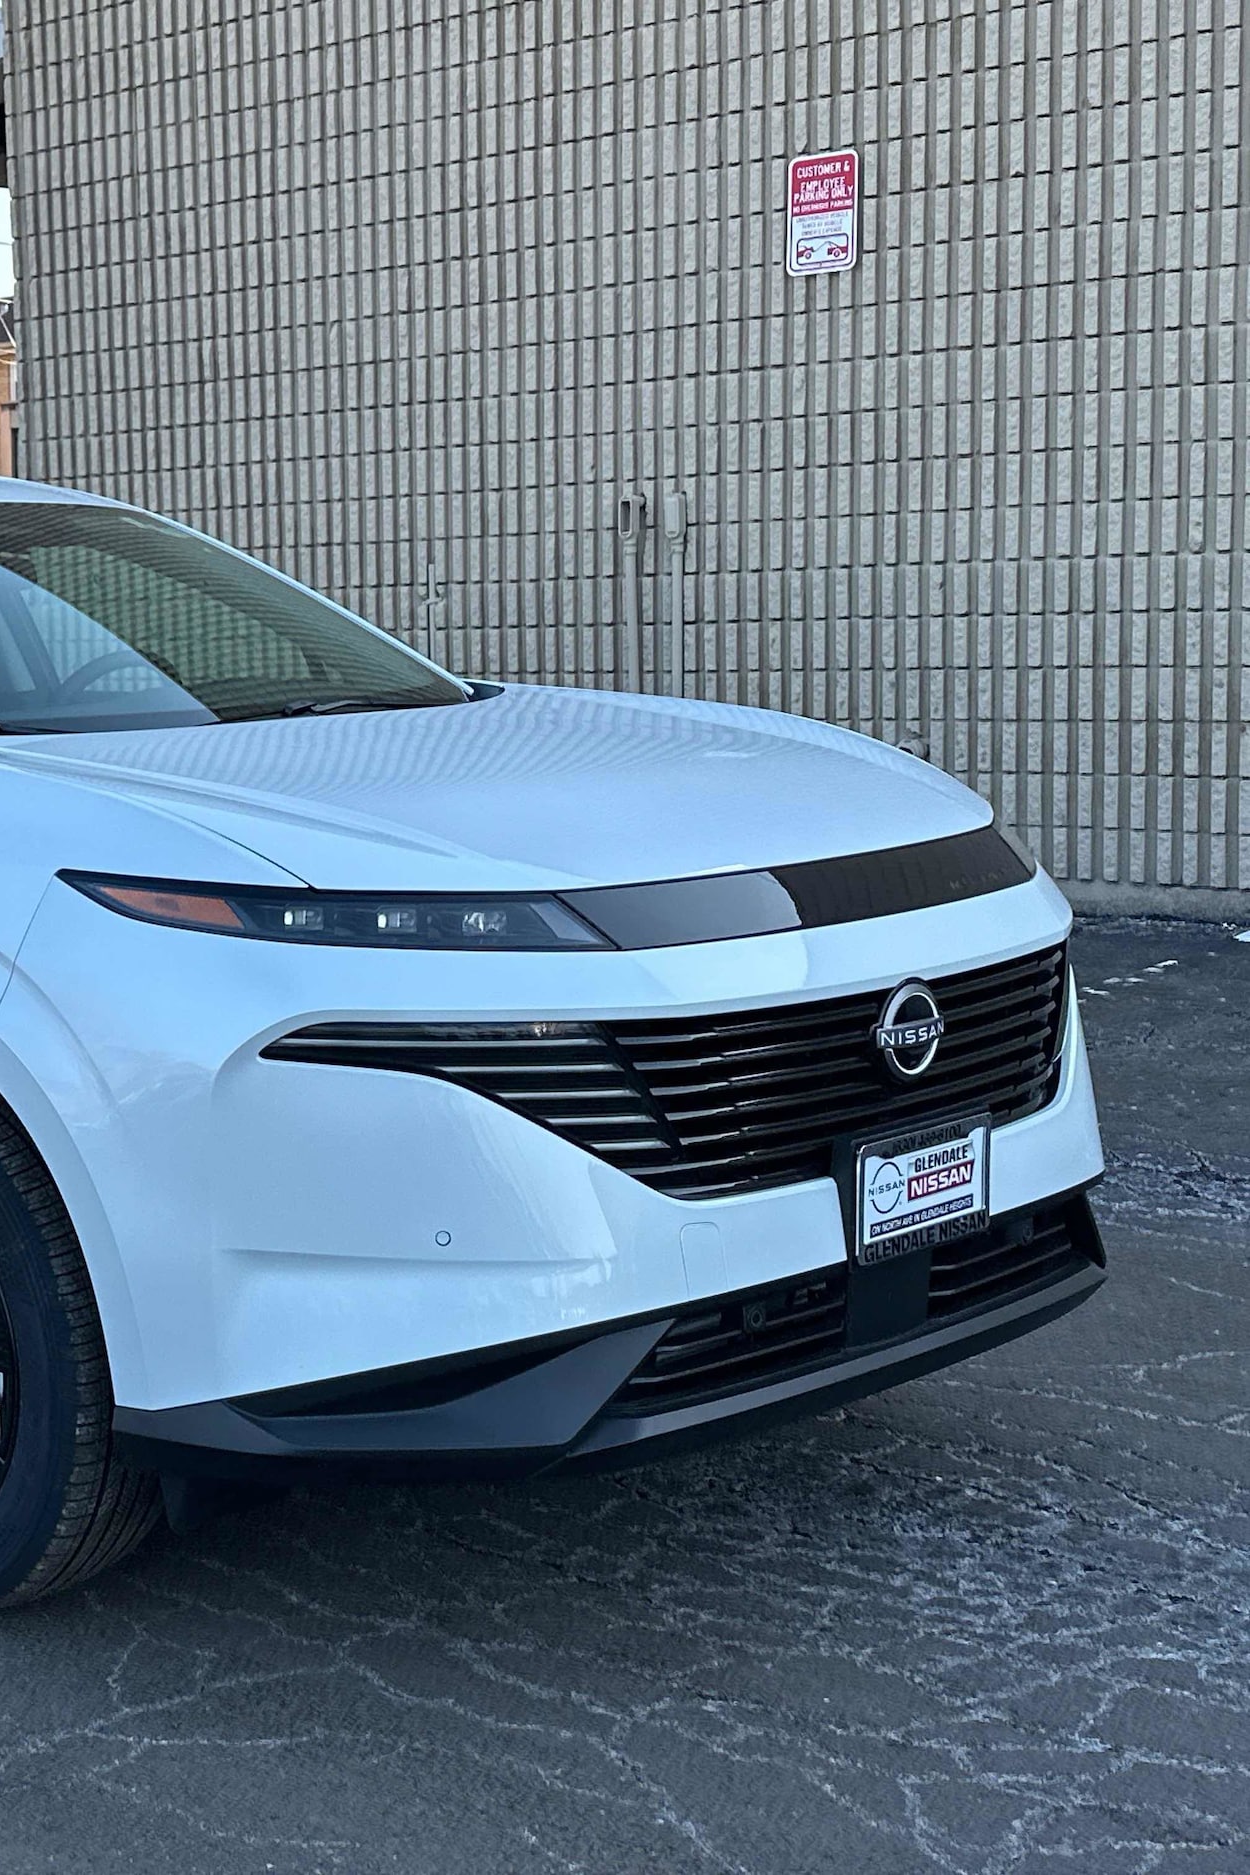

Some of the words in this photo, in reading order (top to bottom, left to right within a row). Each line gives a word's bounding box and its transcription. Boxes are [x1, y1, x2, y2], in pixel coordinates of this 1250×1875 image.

[796, 161, 842, 178] CUSTOMER
[844, 160, 850, 172] &
[793, 189, 830, 204] PARKING
[831, 185, 854, 199] ONLY
[800, 176, 846, 193] EMPLOYEE
[793, 205, 801, 213] NO
[880, 1020, 944, 1046] NISSAN
[914, 1144, 968, 1173] GLENDALE
[868, 1179, 906, 1197] NISSAN
[910, 1163, 972, 1198] NISSAN
[871, 1224, 881, 1236] ON
[881, 1218, 902, 1232] NORTH
[913, 1212, 920, 1223] IN
[921, 1203, 949, 1220] GLENDALE
[949, 1197, 972, 1212] HEIGHTS
[864, 1226, 936, 1263] GLENDALE
[938, 1211, 987, 1242] NISSAN
